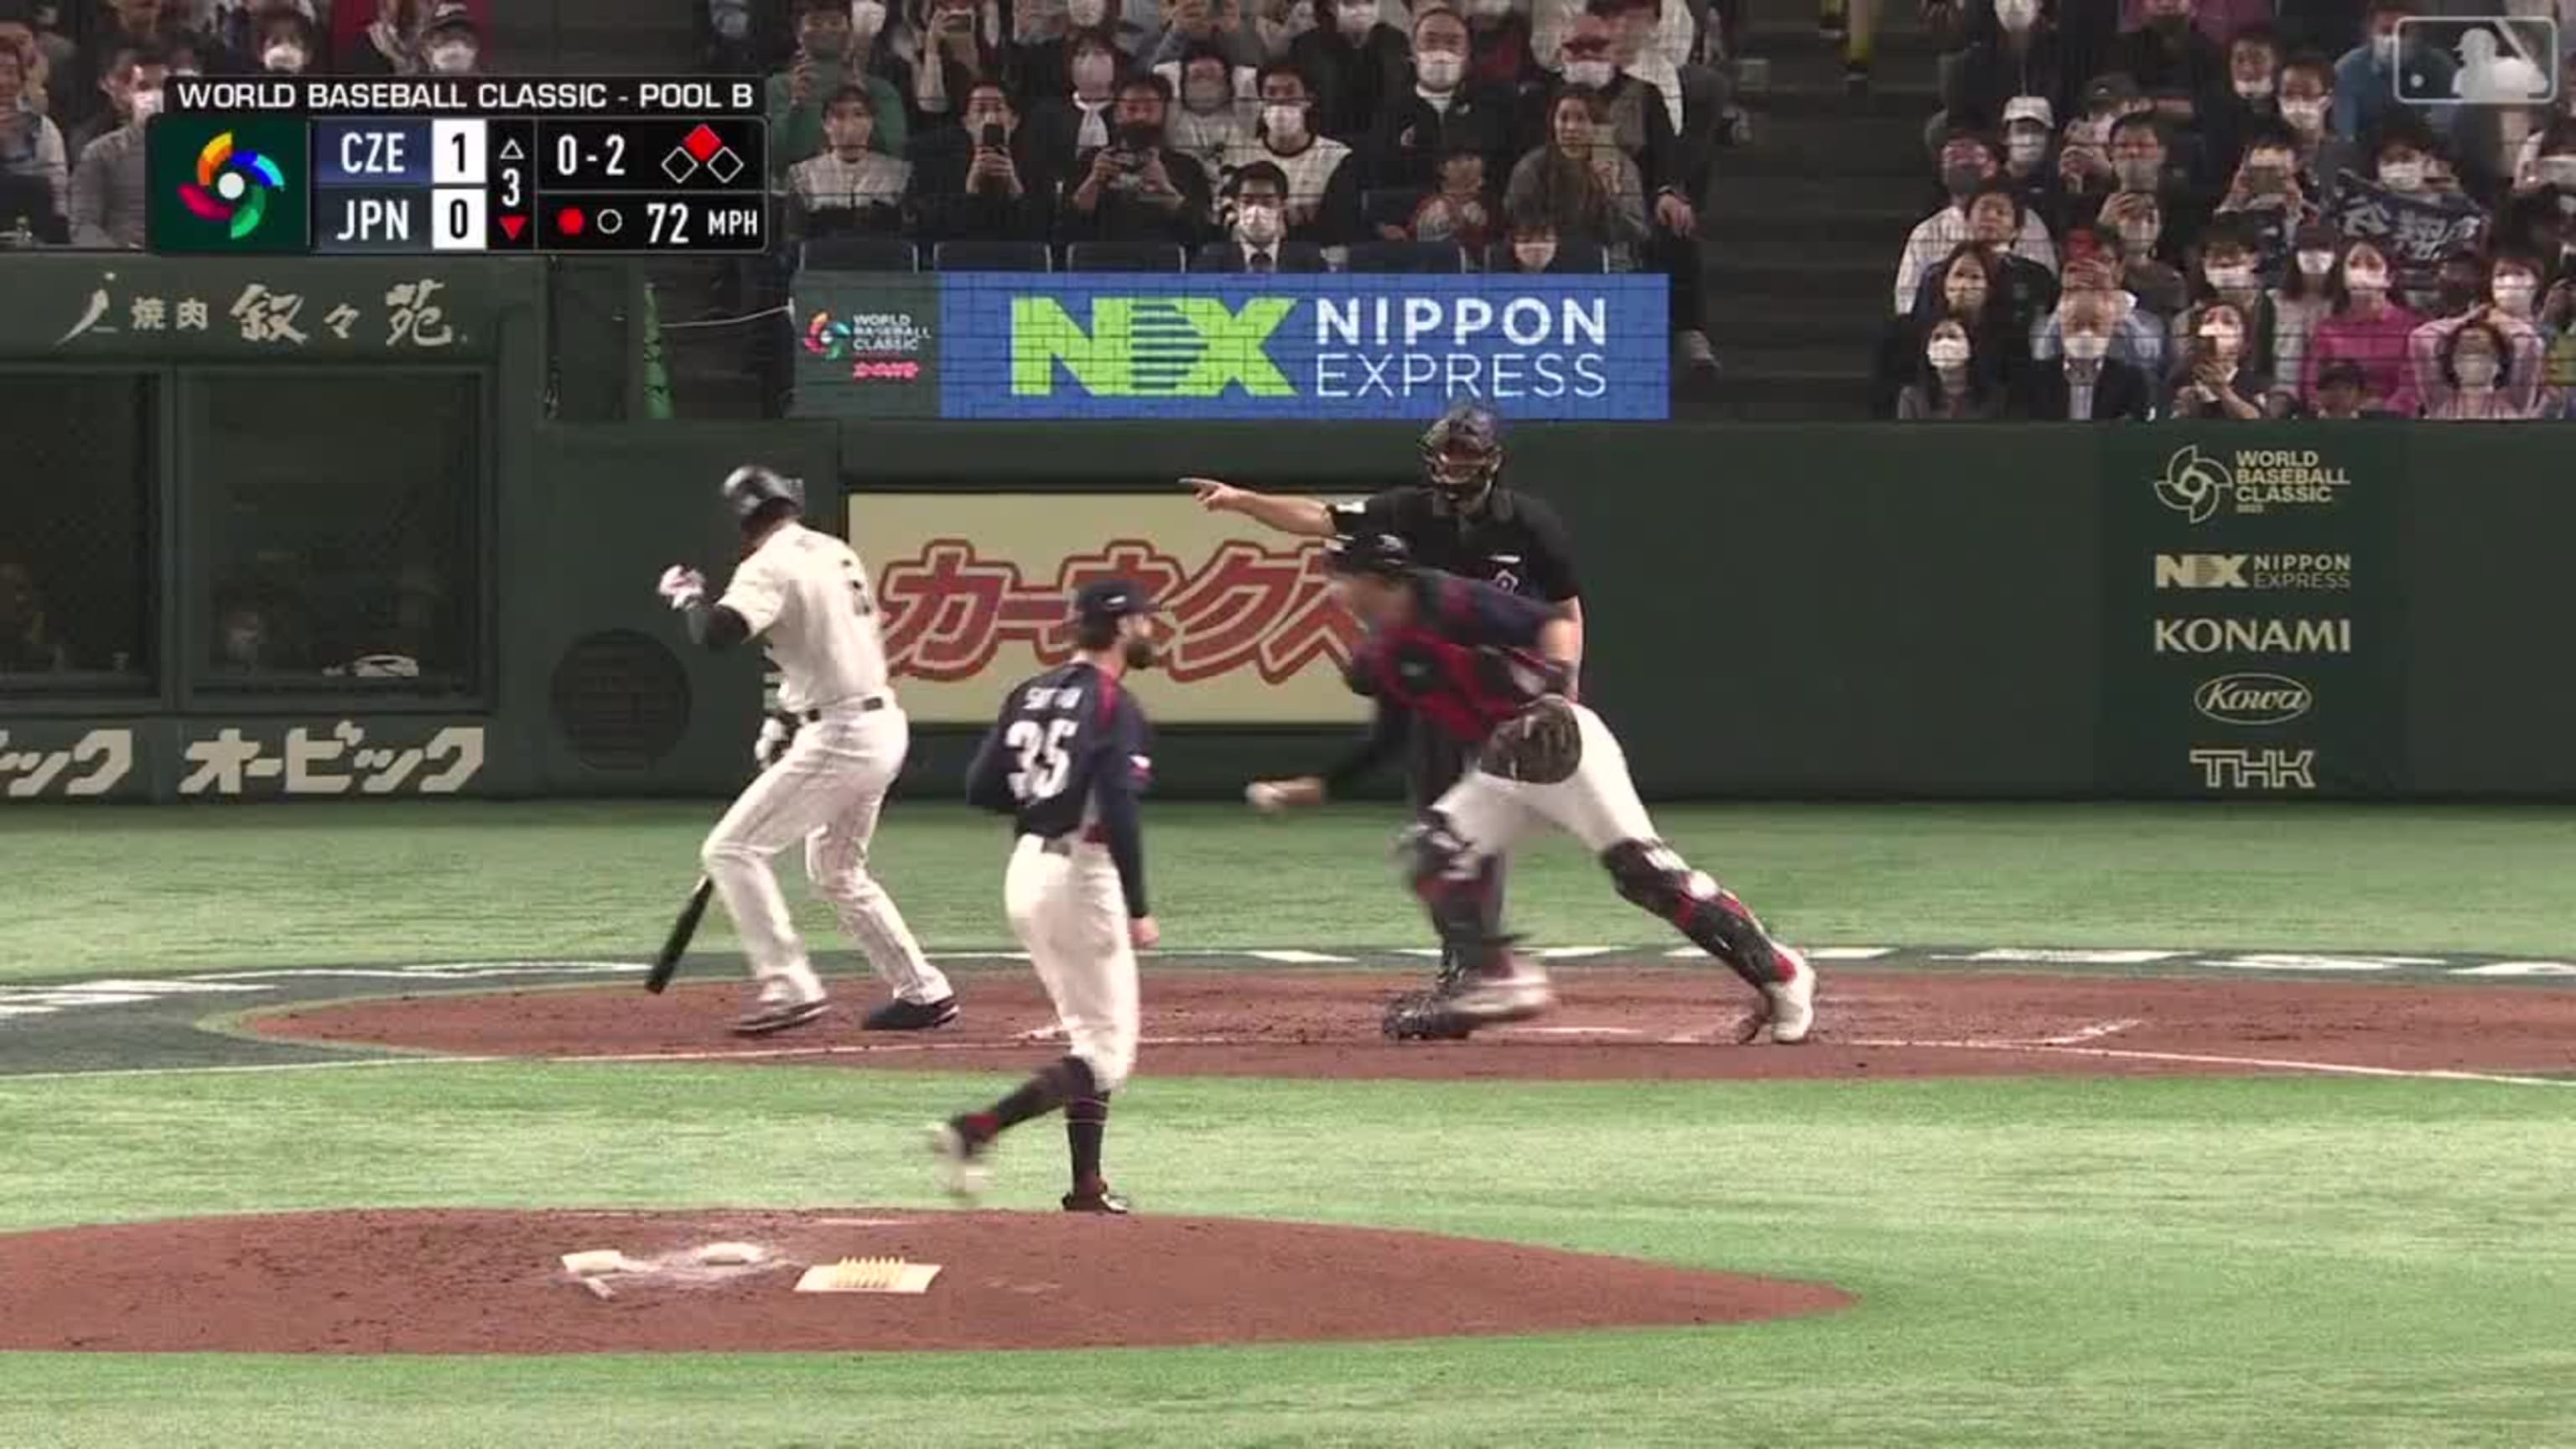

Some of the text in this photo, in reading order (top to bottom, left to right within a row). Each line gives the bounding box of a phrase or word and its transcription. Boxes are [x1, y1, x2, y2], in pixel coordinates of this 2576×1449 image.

[853, 314, 911, 325] WORLD
[1317, 298, 1606, 345] NIPPON
[1317, 352, 1606, 398] EXPRESS
[2235, 450, 2319, 467] WORLD
[2236, 468, 2350, 486] BASEBALL
[2236, 486, 2332, 503] CLASSIC
[2253, 554, 2351, 571] NIPPON
[2253, 572, 2351, 589] EXPRESS
[2154, 618, 2350, 652] KONAMI
[2205, 682, 2308, 711] Kowa
[0, 729, 132, 796] ック
[179, 720, 485, 793] オービック
[2189, 749, 2317, 788] THK
